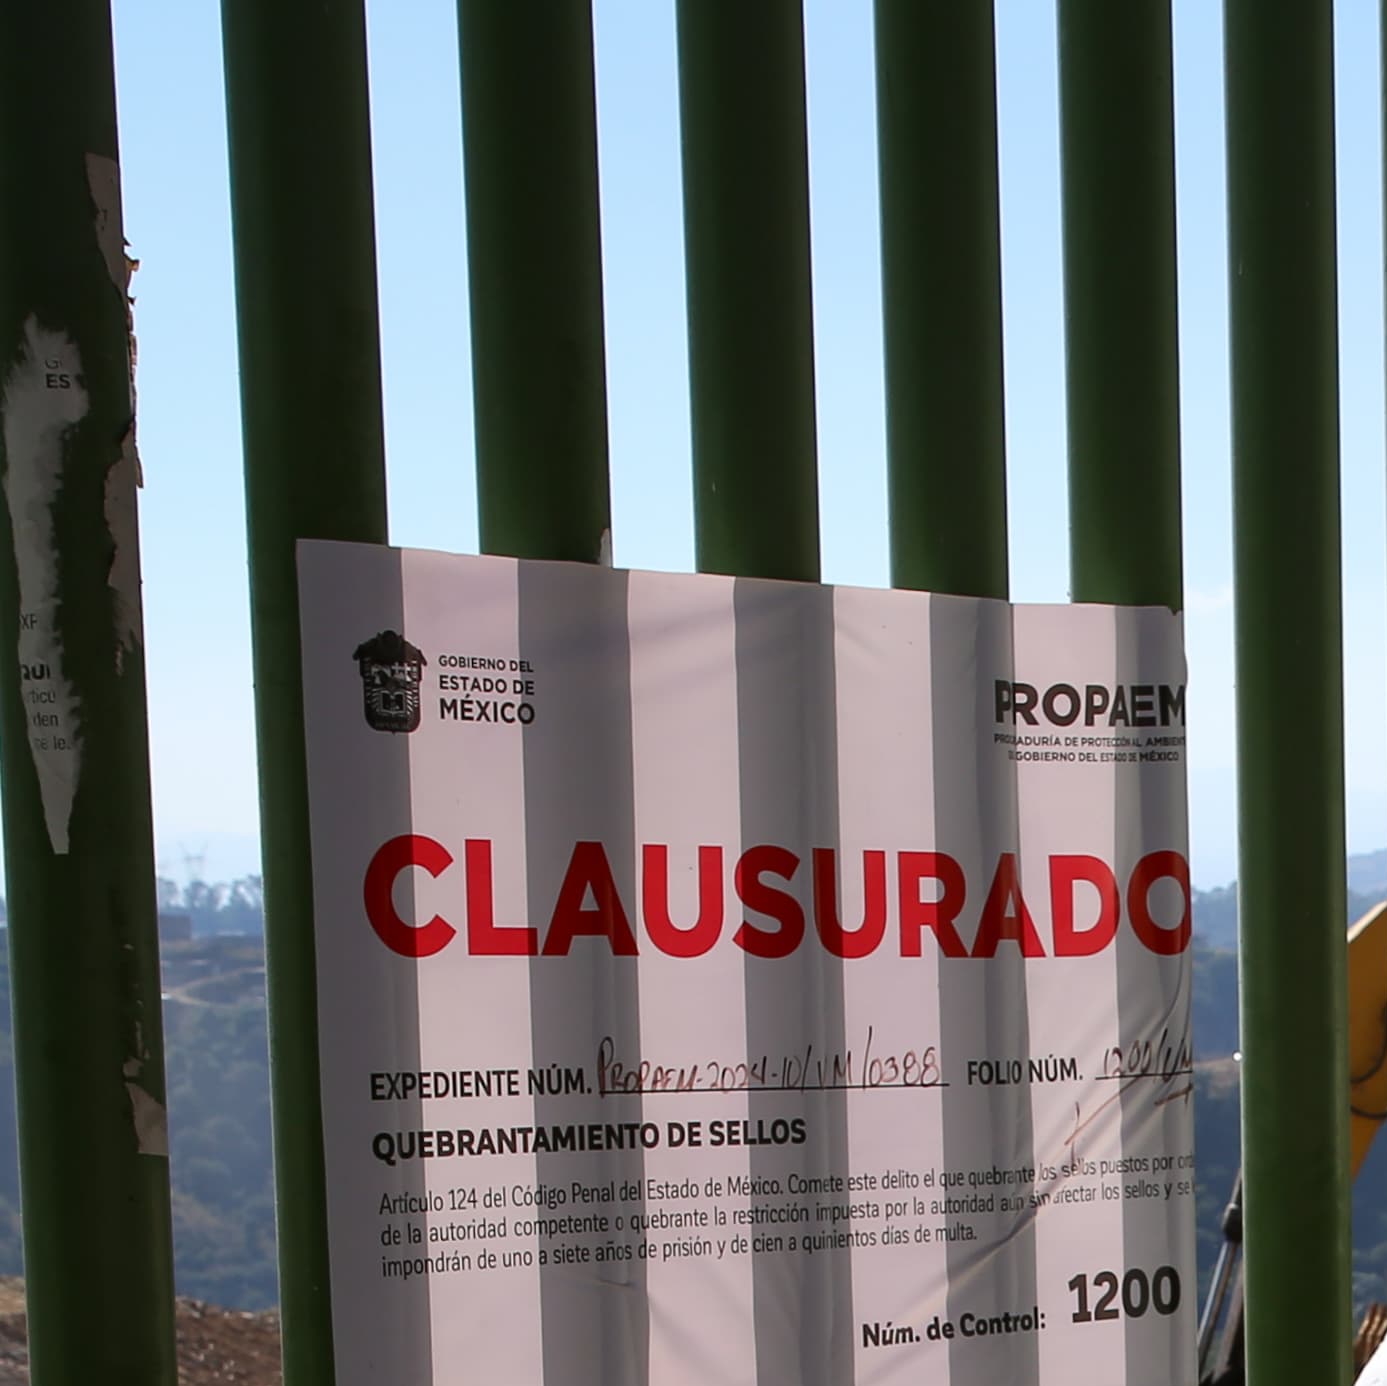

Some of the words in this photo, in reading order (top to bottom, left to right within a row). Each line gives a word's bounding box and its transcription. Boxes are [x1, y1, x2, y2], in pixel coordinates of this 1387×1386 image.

[438, 655, 506, 671] GOBIERNO
[509, 660, 534, 673] DEL
[439, 674, 508, 694] ESTADO
[513, 680, 535, 696] DE
[440, 693, 535, 725] MÉXICO
[1015, 751, 1075, 761] GOBIERNO
[1078, 752, 1098, 762] DEL
[1140, 749, 1179, 761] MÉXICO
[1065, 736, 1078, 747] DE
[363, 834, 1192, 960] CLAUSURADO
[370, 1070, 520, 1101] EXPEDIENTE
[528, 1063, 592, 1096] NÚM.
[968, 1061, 1022, 1085] FOLIO
[1029, 1054, 1083, 1083] NÚM.
[372, 1122, 660, 1166] QUEBRANTAMIENTO
[667, 1121, 701, 1147] DE
[709, 1118, 807, 1146] SELLOS
[380, 1190, 443, 1215] Artículo
[450, 1188, 477, 1210] 124
[483, 1186, 506, 1208] del
[511, 1184, 566, 1209] Código
[572, 1182, 614, 1203] Penal
[619, 1180, 641, 1201] del
[647, 1179, 699, 1200] Estado
[704, 1177, 722, 1198] de
[727, 1175, 783, 1197] México.
[788, 1173, 843, 1194] Comete
[848, 1173, 876, 1191] este
[881, 1169, 919, 1190] delito
[923, 1168, 935, 1187] el
[939, 1170, 964, 1191] que
[968, 1166, 1035, 1190] quebrante
[1039, 1163, 1057, 1182] los
[1100, 1157, 1148, 1178] puestos
[1152, 1156, 1174, 1175] por
[381, 1224, 400, 1246] de
[407, 1222, 422, 1244] la
[429, 1216, 507, 1242] autoridad
[514, 1212, 608, 1239] competente
[615, 1216, 624, 1231] o
[630, 1208, 708, 1234] quebrante
[714, 1205, 726, 1226] la
[732, 1202, 809, 1225] restricción
[815, 1201, 879, 1225] impuesta
[885, 1201, 908, 1222] por
[913, 1197, 925, 1216] la
[930, 1193, 994, 1215] autoridad
[1000, 1196, 1024, 1213] aún
[1029, 1190, 1050, 1209] sin
[1101, 1182, 1120, 1200] los
[1125, 1179, 1160, 1199] sellos
[1164, 1183, 1173, 1200] y
[382, 1249, 471, 1280] impondrán
[477, 1248, 497, 1270] de
[502, 1250, 533, 1268] uno
[538, 1250, 548, 1266] a
[553, 1243, 590, 1264] siete
[595, 1240, 633, 1262] años
[638, 1238, 657, 1259] de
[662, 1234, 712, 1262] prisión
[717, 1240, 726, 1260] y
[730, 1233, 748, 1255] de
[752, 1234, 783, 1253] cien
[788, 1235, 797, 1251] a
[802, 1229, 877, 1254] quinientos
[881, 1224, 910, 1245] días
[914, 1224, 931, 1244] de
[935, 1221, 977, 1242] multa.
[862, 1321, 921, 1348] Núm.
[926, 1316, 955, 1342] de
[959, 1306, 1046, 1338] Control:
[1068, 1265, 1181, 1323] 1200
